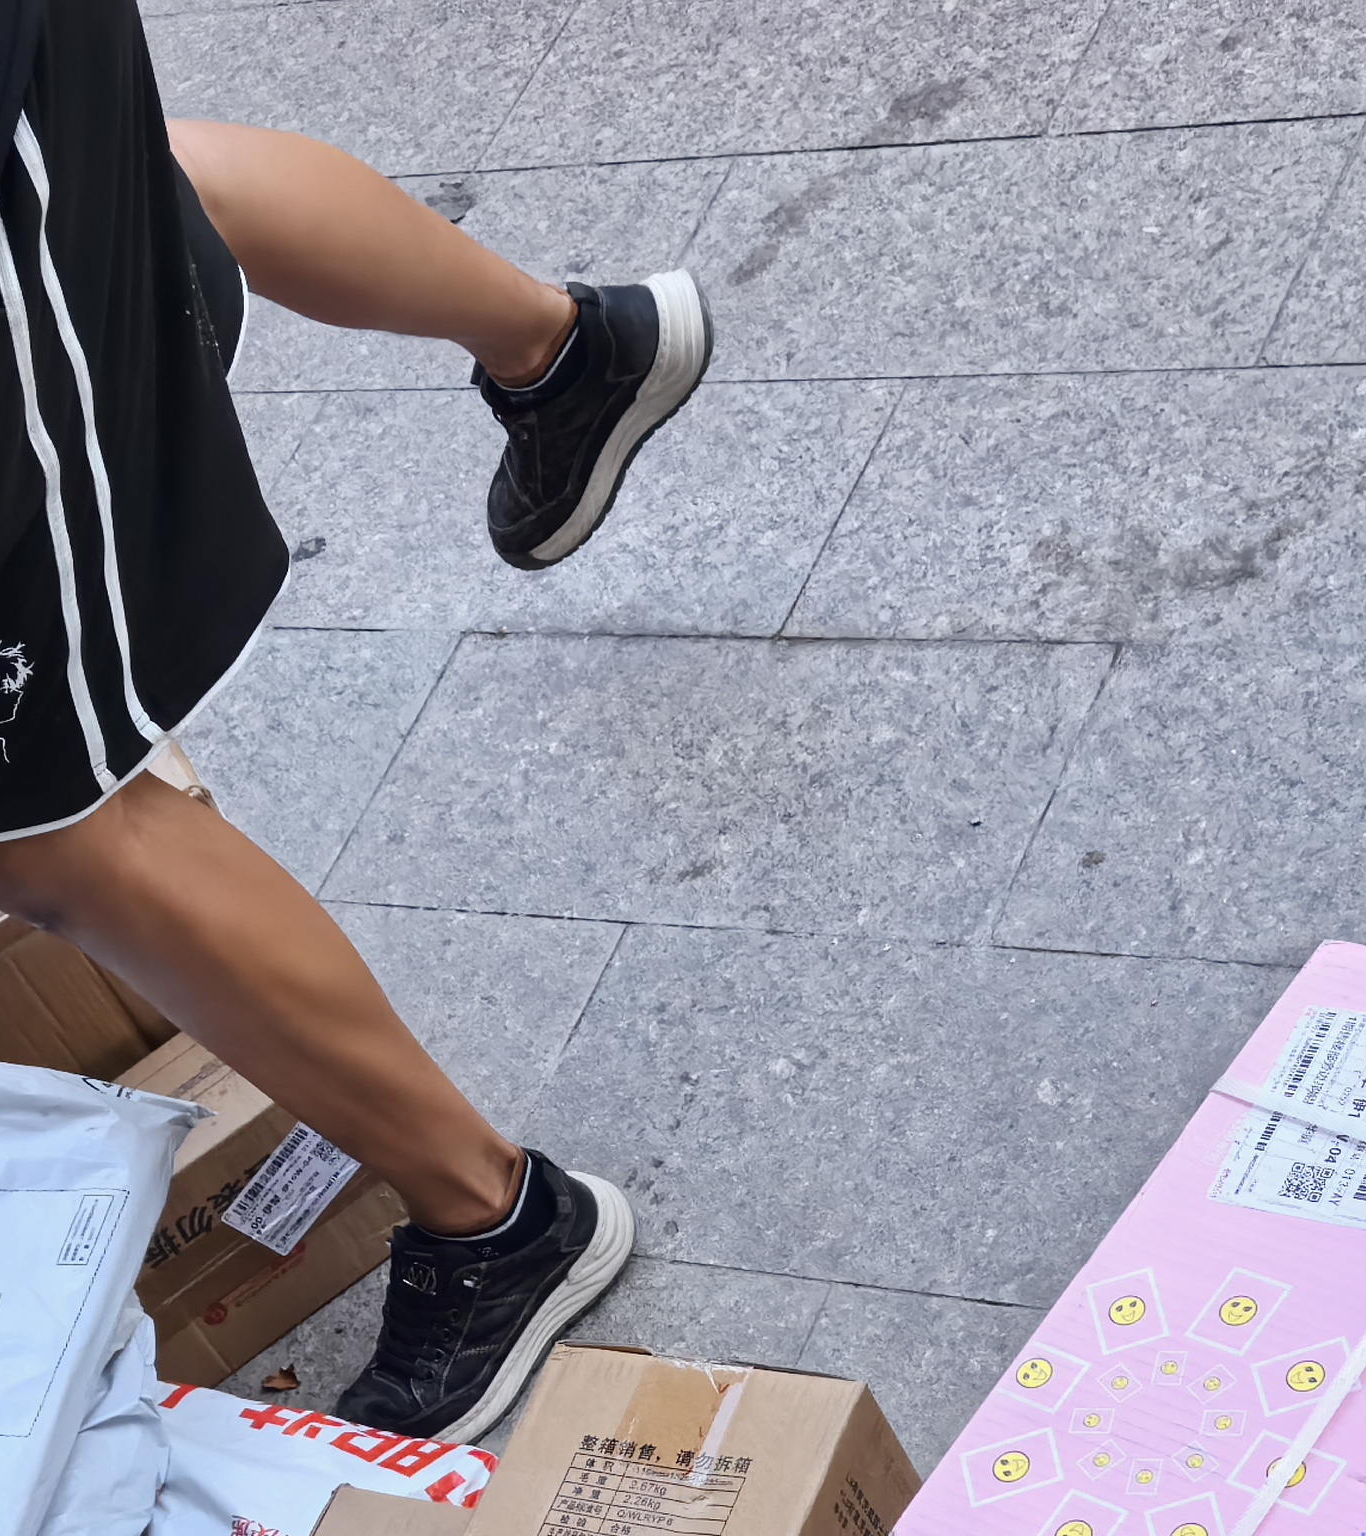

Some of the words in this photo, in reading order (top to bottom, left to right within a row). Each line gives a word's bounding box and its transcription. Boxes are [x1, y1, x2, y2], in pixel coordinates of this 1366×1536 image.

[578, 1433, 753, 1475] 整箱销售，请勿拆箱
[610, 1522, 631, 1534] 合格
